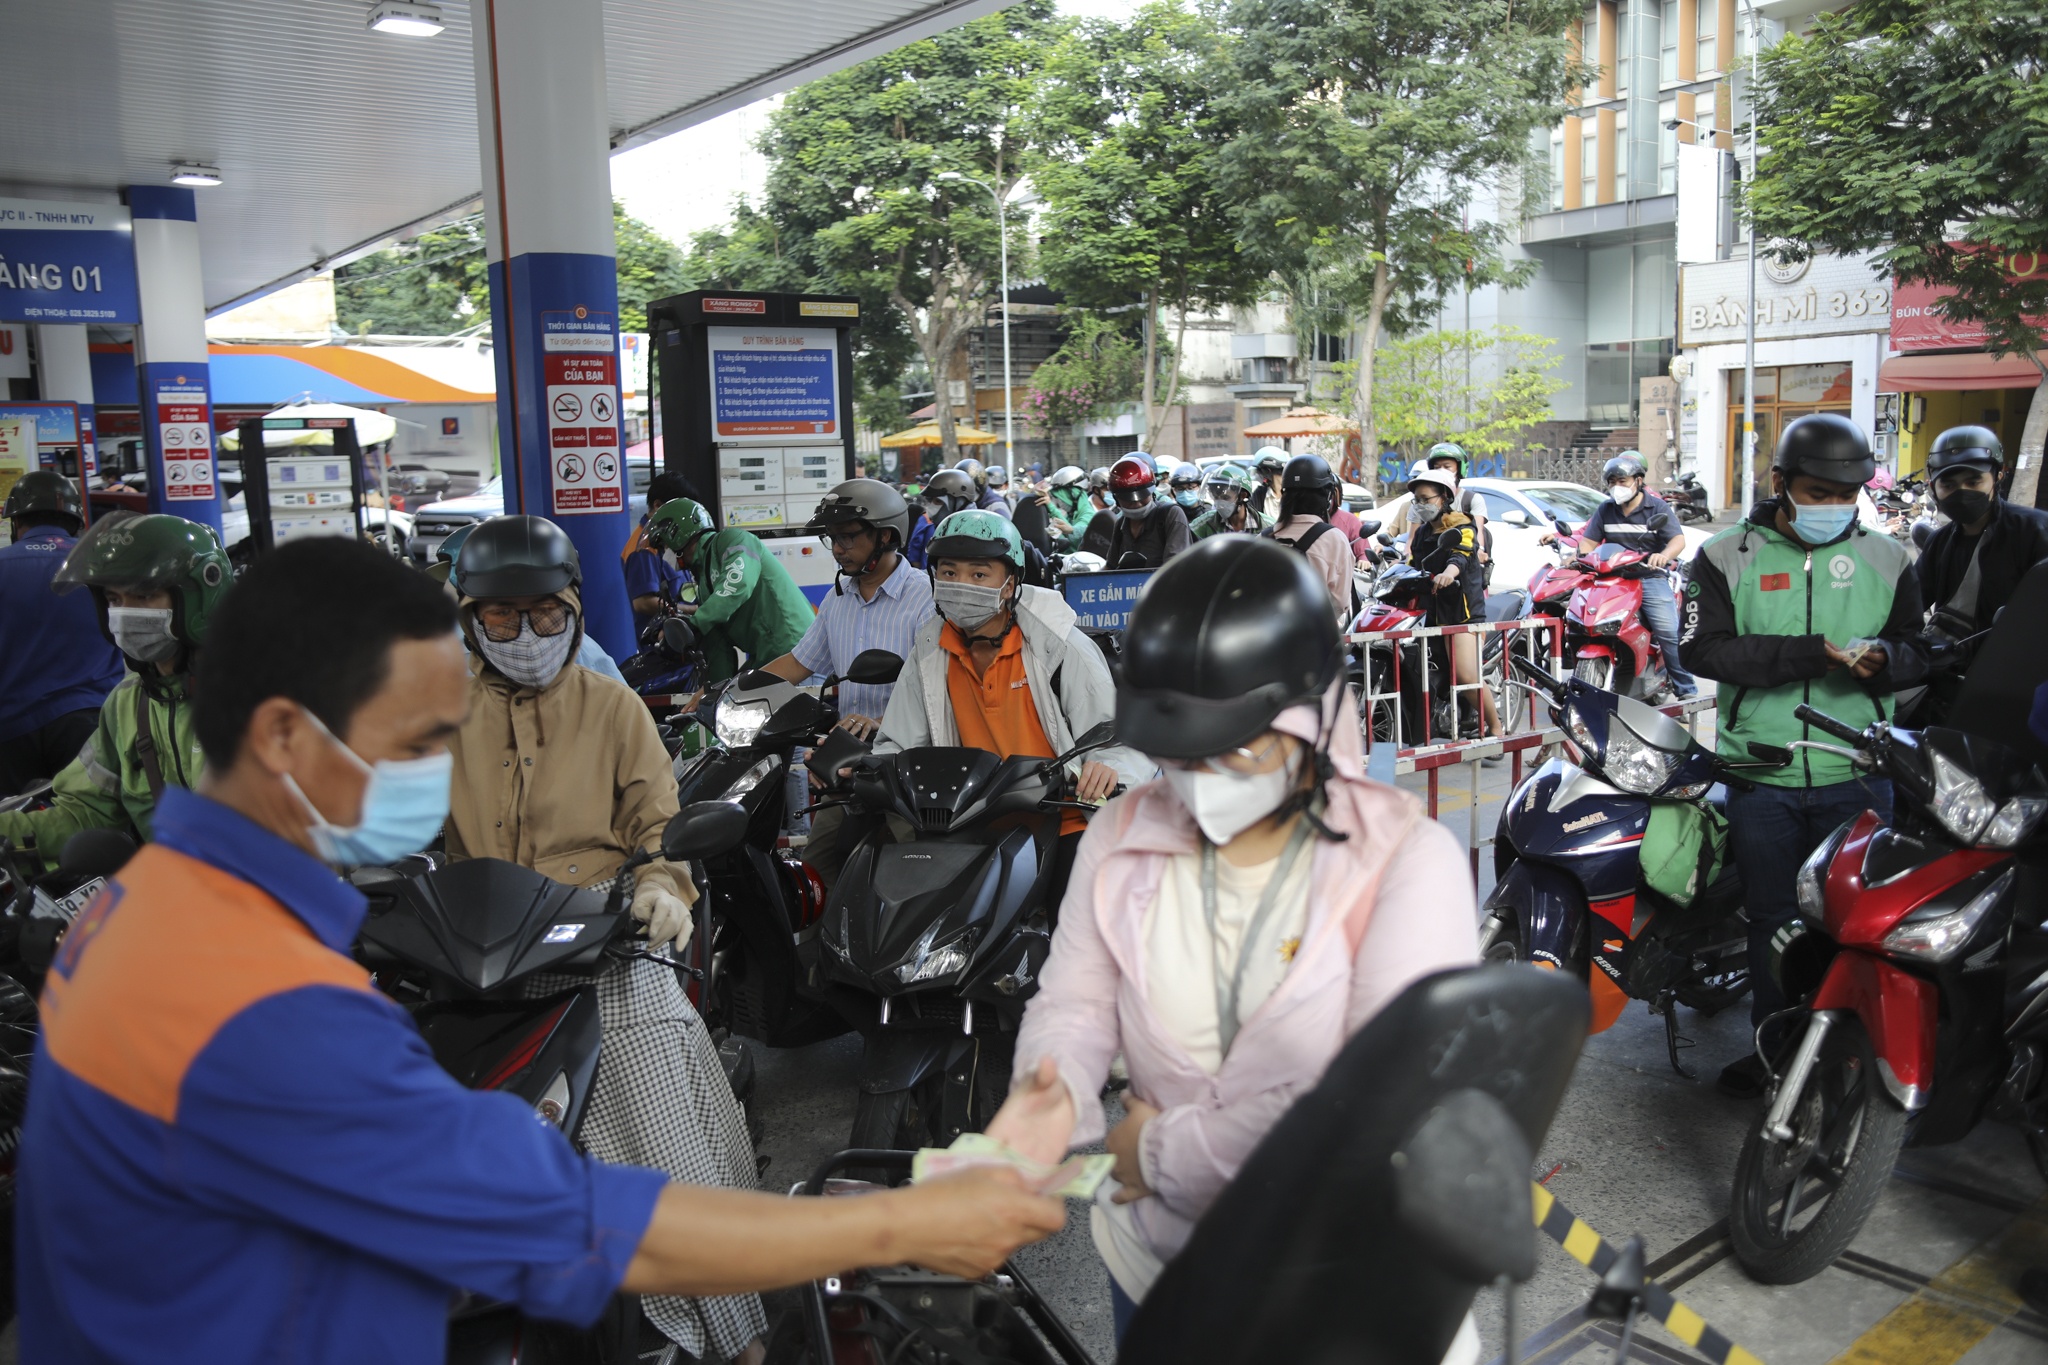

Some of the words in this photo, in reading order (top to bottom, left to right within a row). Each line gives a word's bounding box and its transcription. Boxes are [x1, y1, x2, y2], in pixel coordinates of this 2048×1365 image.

[19, 211, 25, 220] II
[35, 212, 67, 223] TNHH
[71, 214, 95, 225] MTV
[71, 266, 102, 292] 01
[1690, 295, 1773, 330] BÁNH
[1781, 286, 1817, 324] MÌ
[1828, 288, 1890, 318] 362
[1896, 306, 1920, 318] BÚN
[566, 322, 582, 330] GIAN
[583, 321, 596, 330] BÁN
[743, 336, 755, 345] QUY
[775, 335, 787, 345] BÁN
[788, 336, 804, 346] HÀNG
[564, 368, 584, 381] CỦA
[586, 370, 604, 383] BẠN
[1080, 589, 1096, 603] XE
[1099, 582, 1123, 602] GẮN
[1831, 580, 1853, 589] gojek
[1097, 610, 1120, 628] VÀO
[1679, 600, 1699, 646] gojek
[1532, 949, 1562, 969] REPSOL
[1592, 955, 1622, 978] REPSOL
